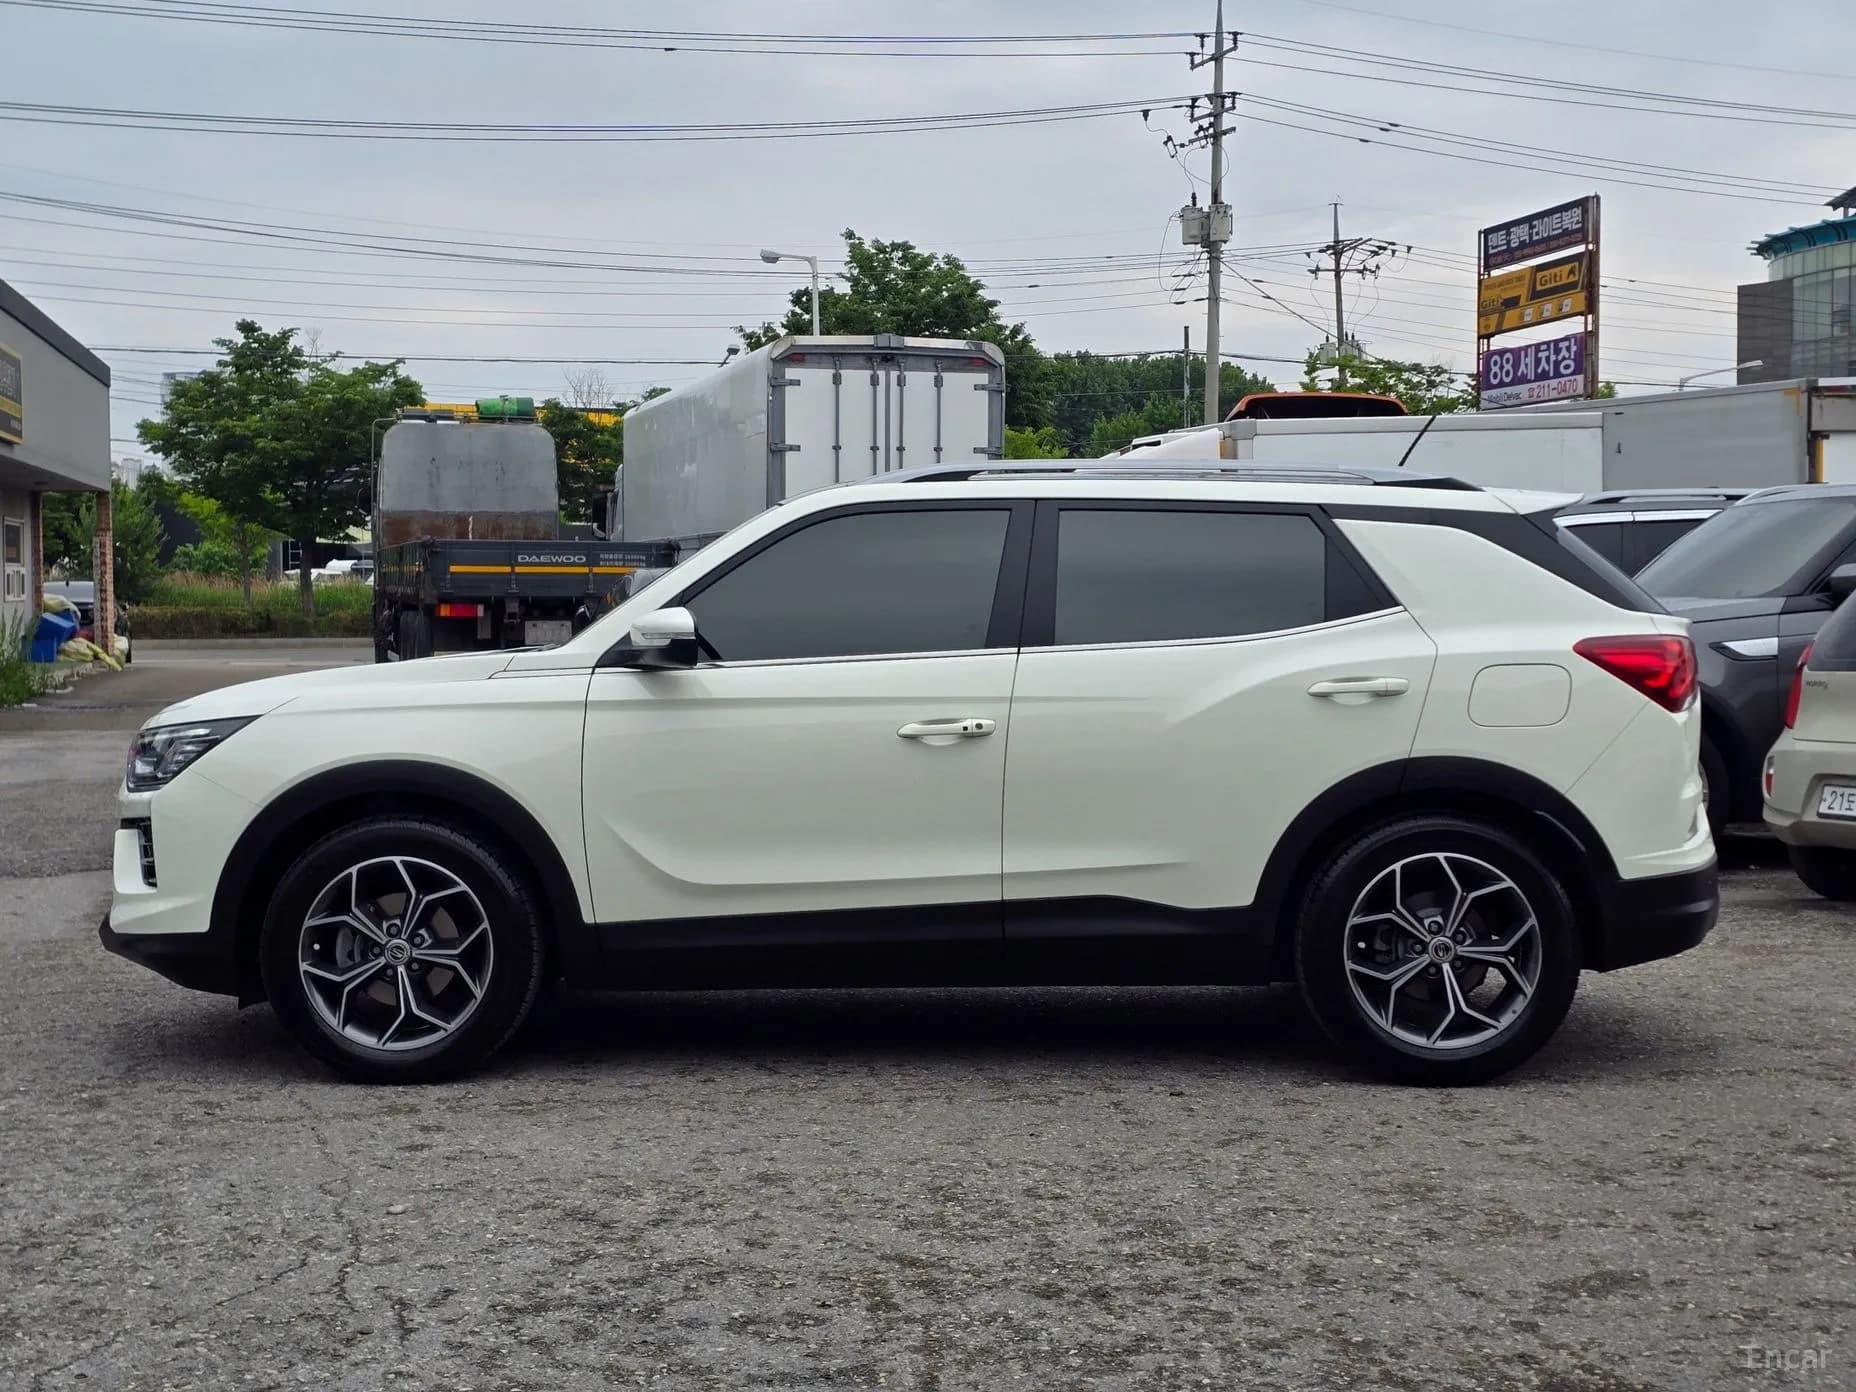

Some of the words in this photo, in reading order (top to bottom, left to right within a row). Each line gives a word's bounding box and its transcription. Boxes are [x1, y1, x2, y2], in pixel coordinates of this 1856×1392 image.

[1539, 271, 1563, 287] Giti
[1536, 379, 1578, 398] 211-0470
[517, 554, 587, 563] DAEWOO
